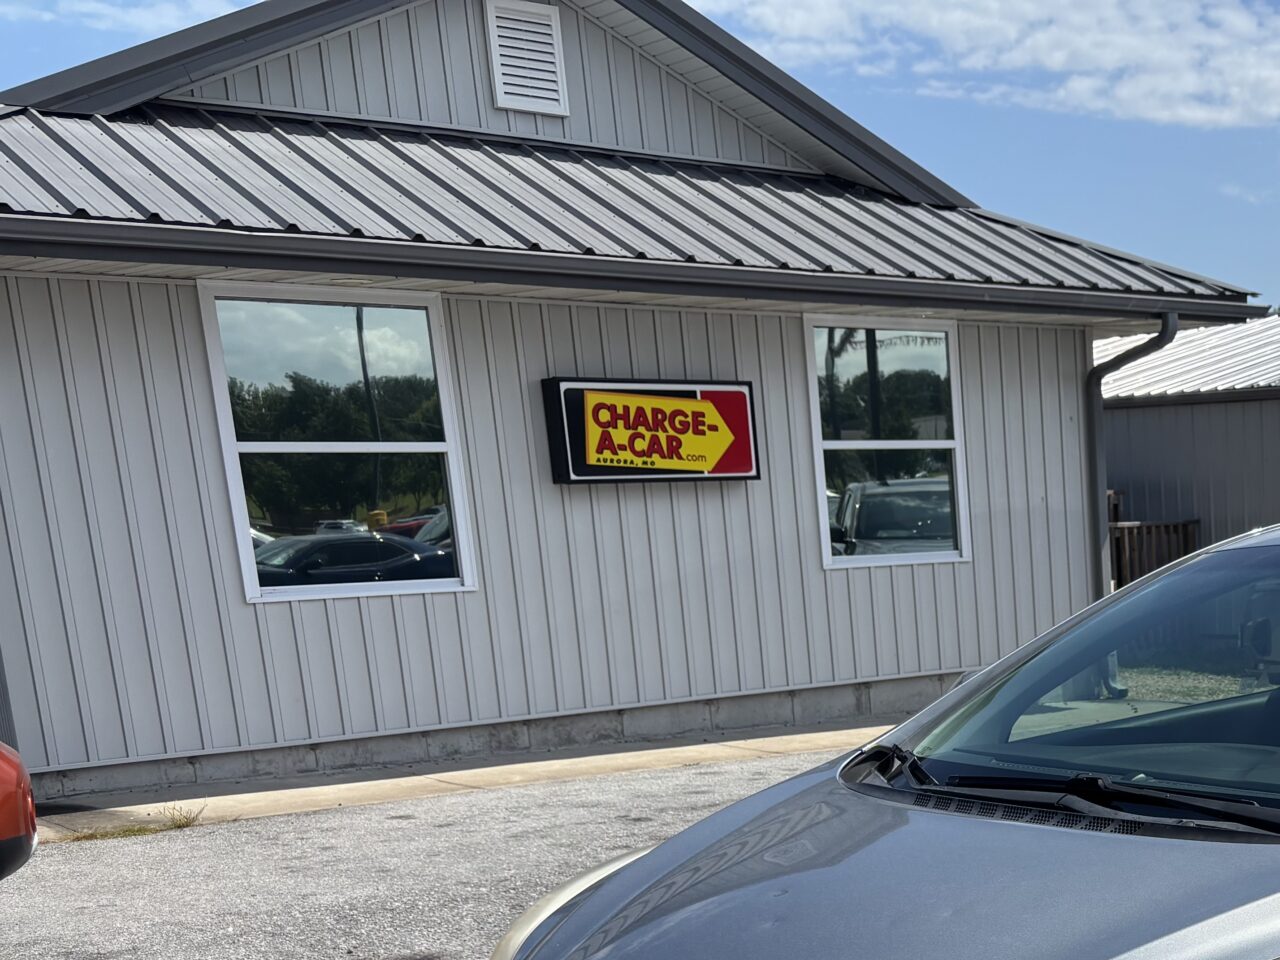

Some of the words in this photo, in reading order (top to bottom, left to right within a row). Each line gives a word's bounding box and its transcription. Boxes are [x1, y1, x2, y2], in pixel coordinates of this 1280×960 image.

[592, 402, 719, 436] CHARGE-
[595, 430, 684, 461] A-CAR
[595, 457, 638, 467] AURORA,
